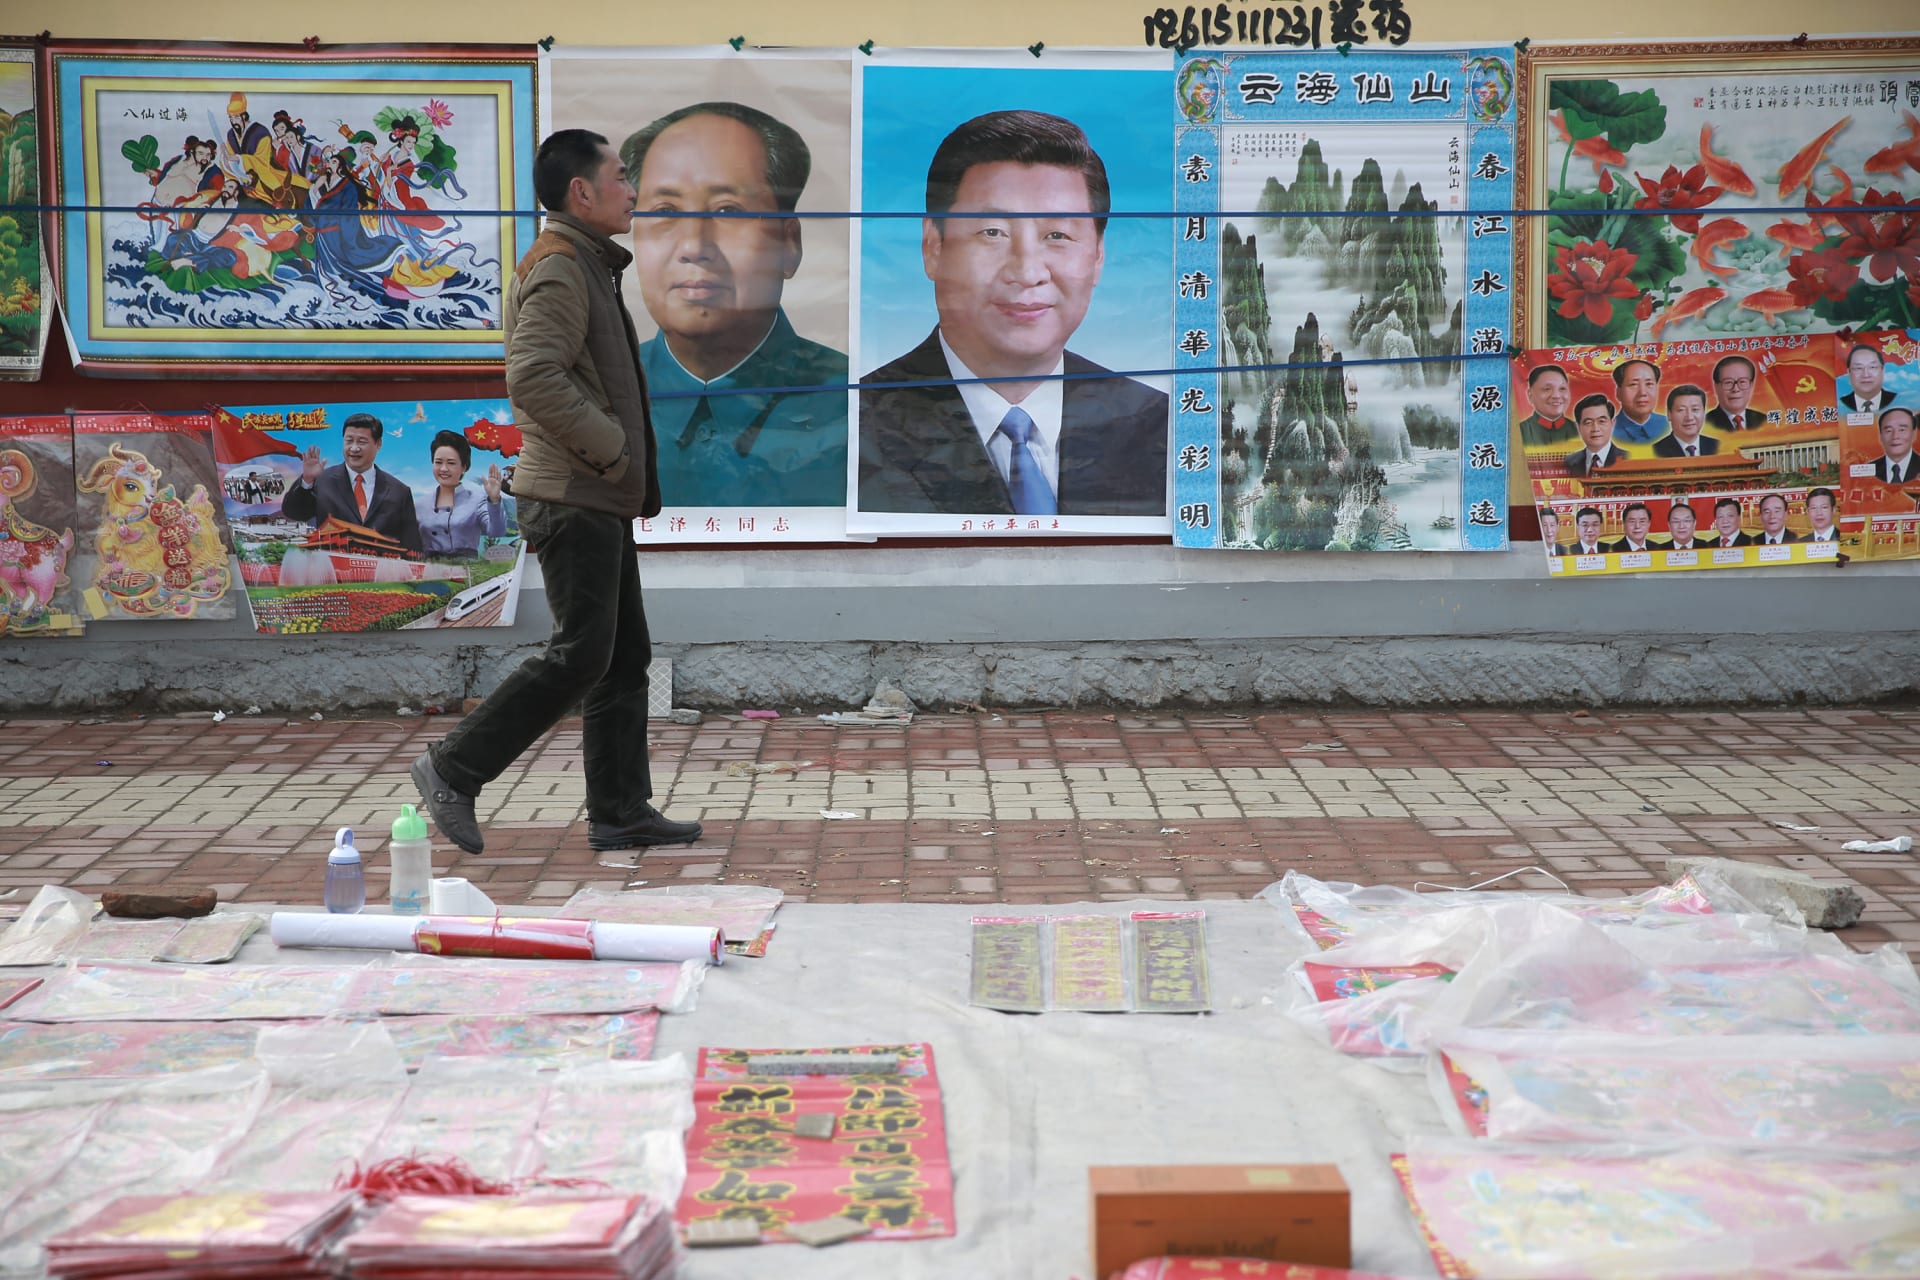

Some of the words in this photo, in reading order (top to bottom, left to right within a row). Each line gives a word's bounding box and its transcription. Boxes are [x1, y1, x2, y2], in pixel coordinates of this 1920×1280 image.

[1239, 72, 1451, 106] 云海仙山
[123, 106, 188, 121] 八仙过海
[1448, 136, 1460, 189] 云海仙山
[1178, 154, 1214, 529] 素月清華光彩明
[1469, 152, 1510, 528] 春江水滿源流遠
[1767, 406, 1839, 427] 辉煌成就
[635, 516, 790, 532] 毛泽东同志
